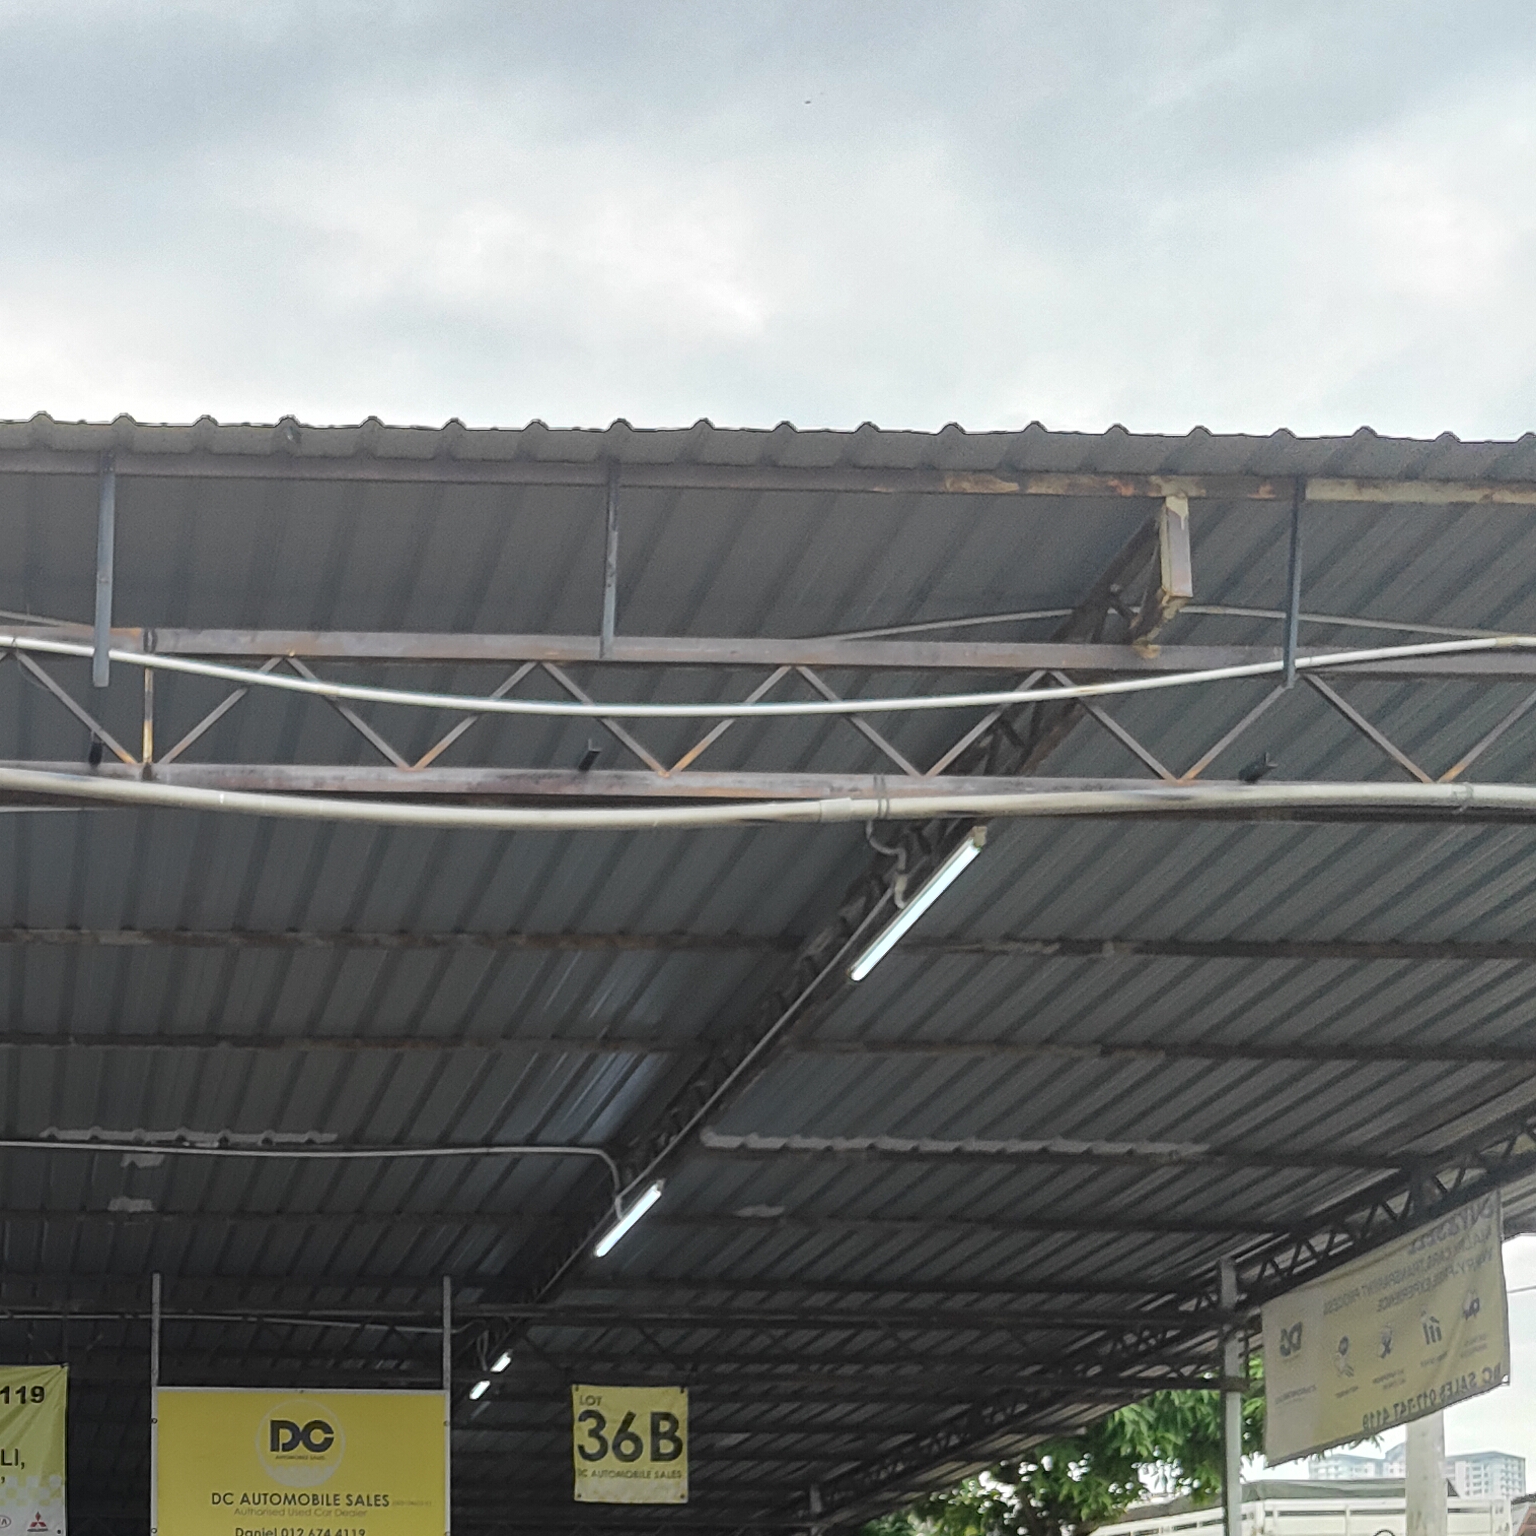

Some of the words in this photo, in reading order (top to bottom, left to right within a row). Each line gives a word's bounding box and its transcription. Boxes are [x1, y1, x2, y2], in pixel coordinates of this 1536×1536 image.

[579, 1395, 602, 1407] LOT
[270, 1419, 335, 1453] DC
[577, 1409, 683, 1463] 36B
[591, 1469, 652, 1479] AUTOMOBILE
[654, 1469, 682, 1479] SALES
[211, 1492, 234, 1506] DC
[240, 1492, 341, 1507] AUTOMOBILE
[345, 1494, 390, 1508] SALES
